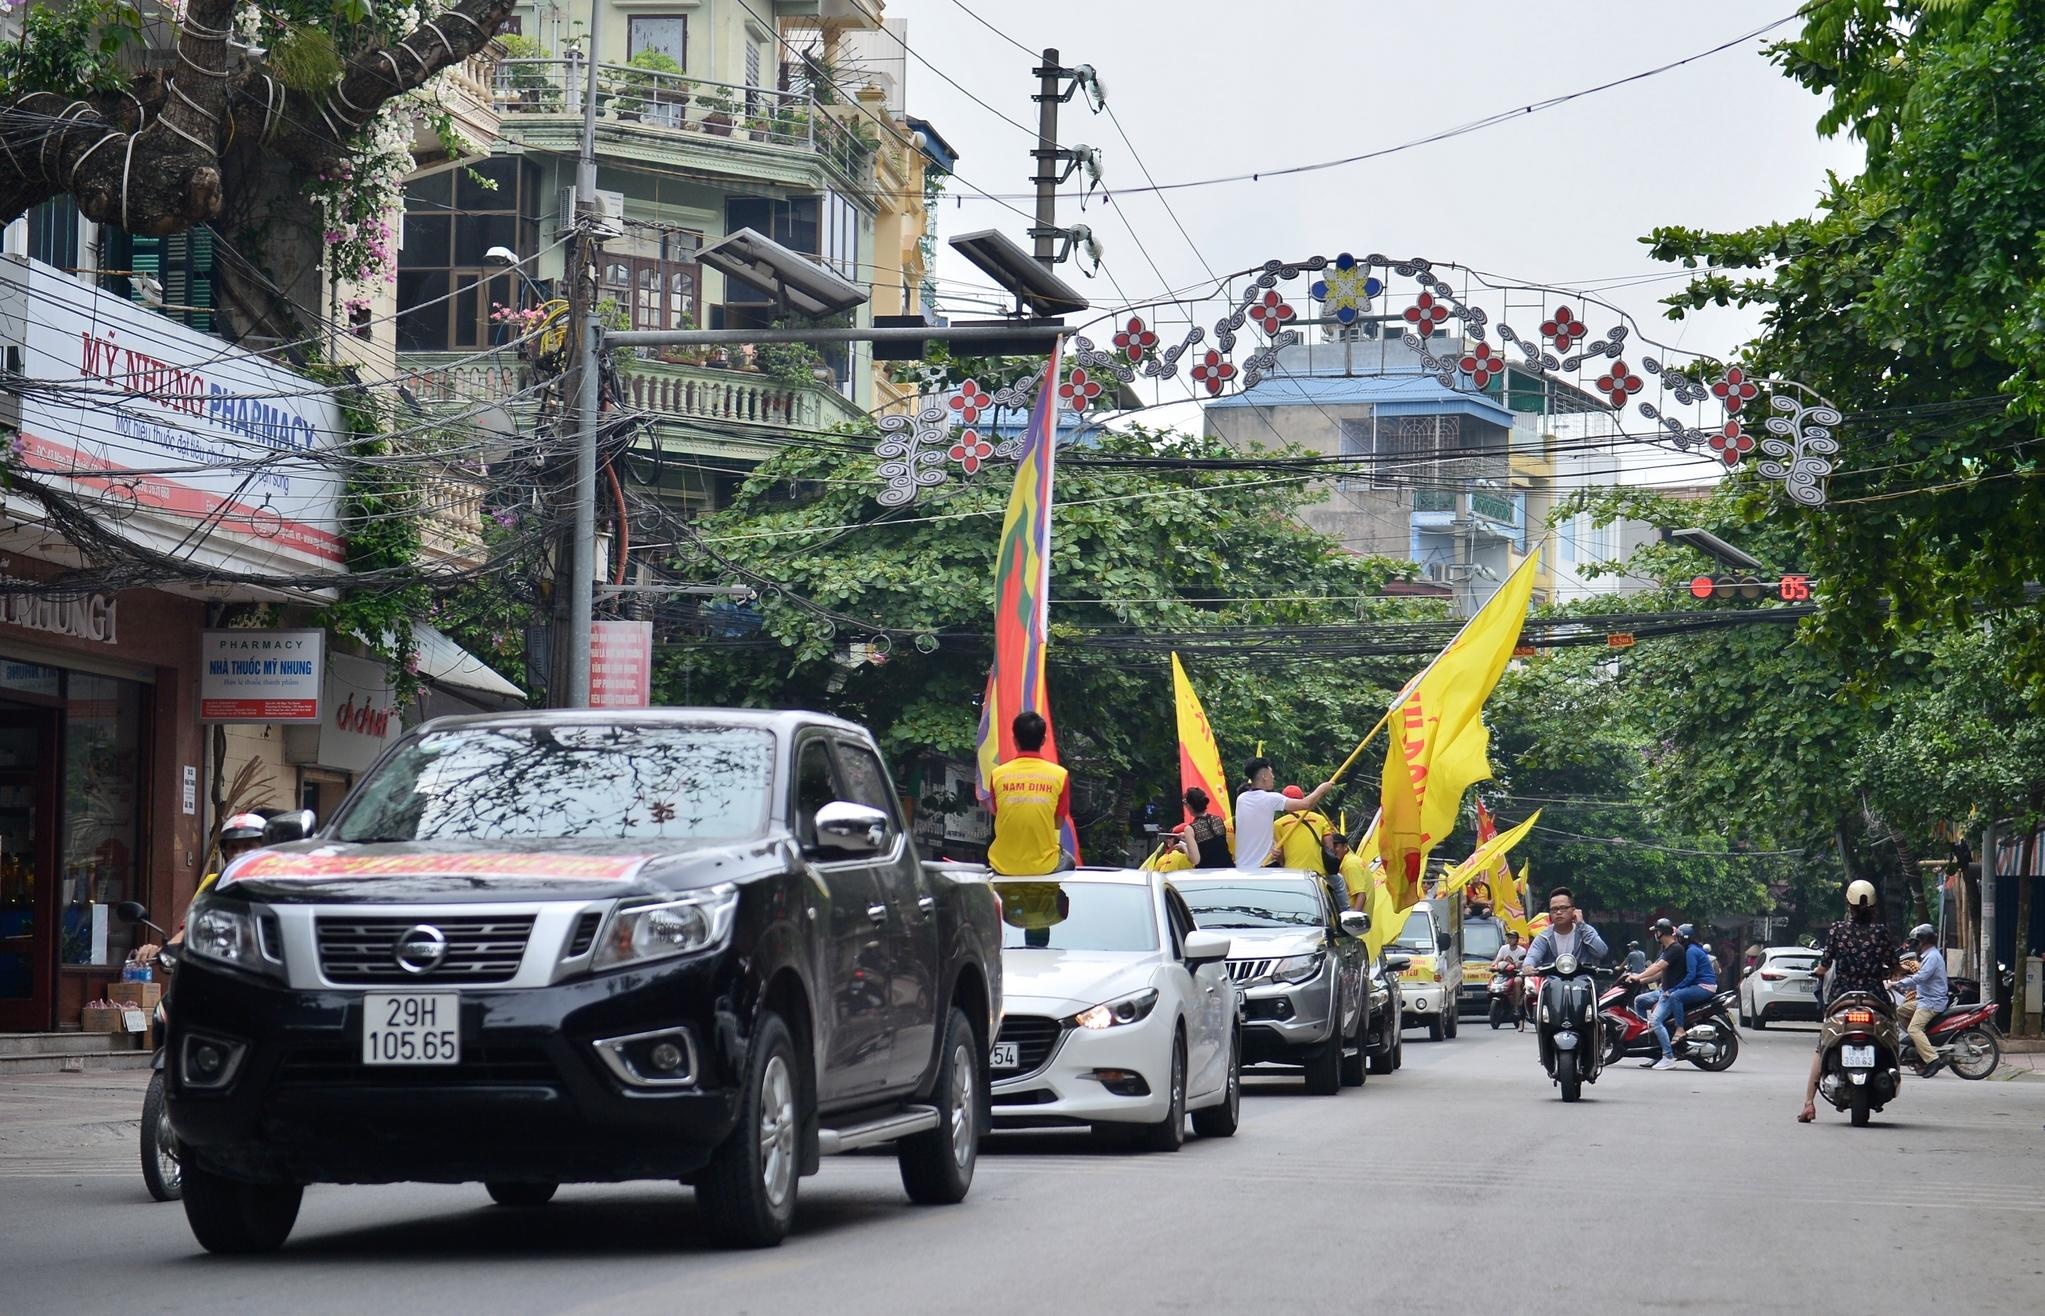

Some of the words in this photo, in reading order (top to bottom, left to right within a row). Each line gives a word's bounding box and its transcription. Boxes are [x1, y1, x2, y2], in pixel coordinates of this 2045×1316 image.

[80, 330, 119, 386] MỸ
[124, 349, 205, 420] NHUNG
[209, 382, 316, 452] PHARMACY
[1781, 575, 1808, 600] 05
[219, 640, 303, 649] PHARMACY
[209, 657, 229, 675] NHÀ
[231, 655, 261, 675] THUỐC
[263, 657, 278, 675] MỸ
[280, 660, 312, 675] NHUNG
[1003, 783, 1024, 792] NAM
[386, 998, 436, 1027] 29H
[369, 1031, 455, 1060] 105.65
